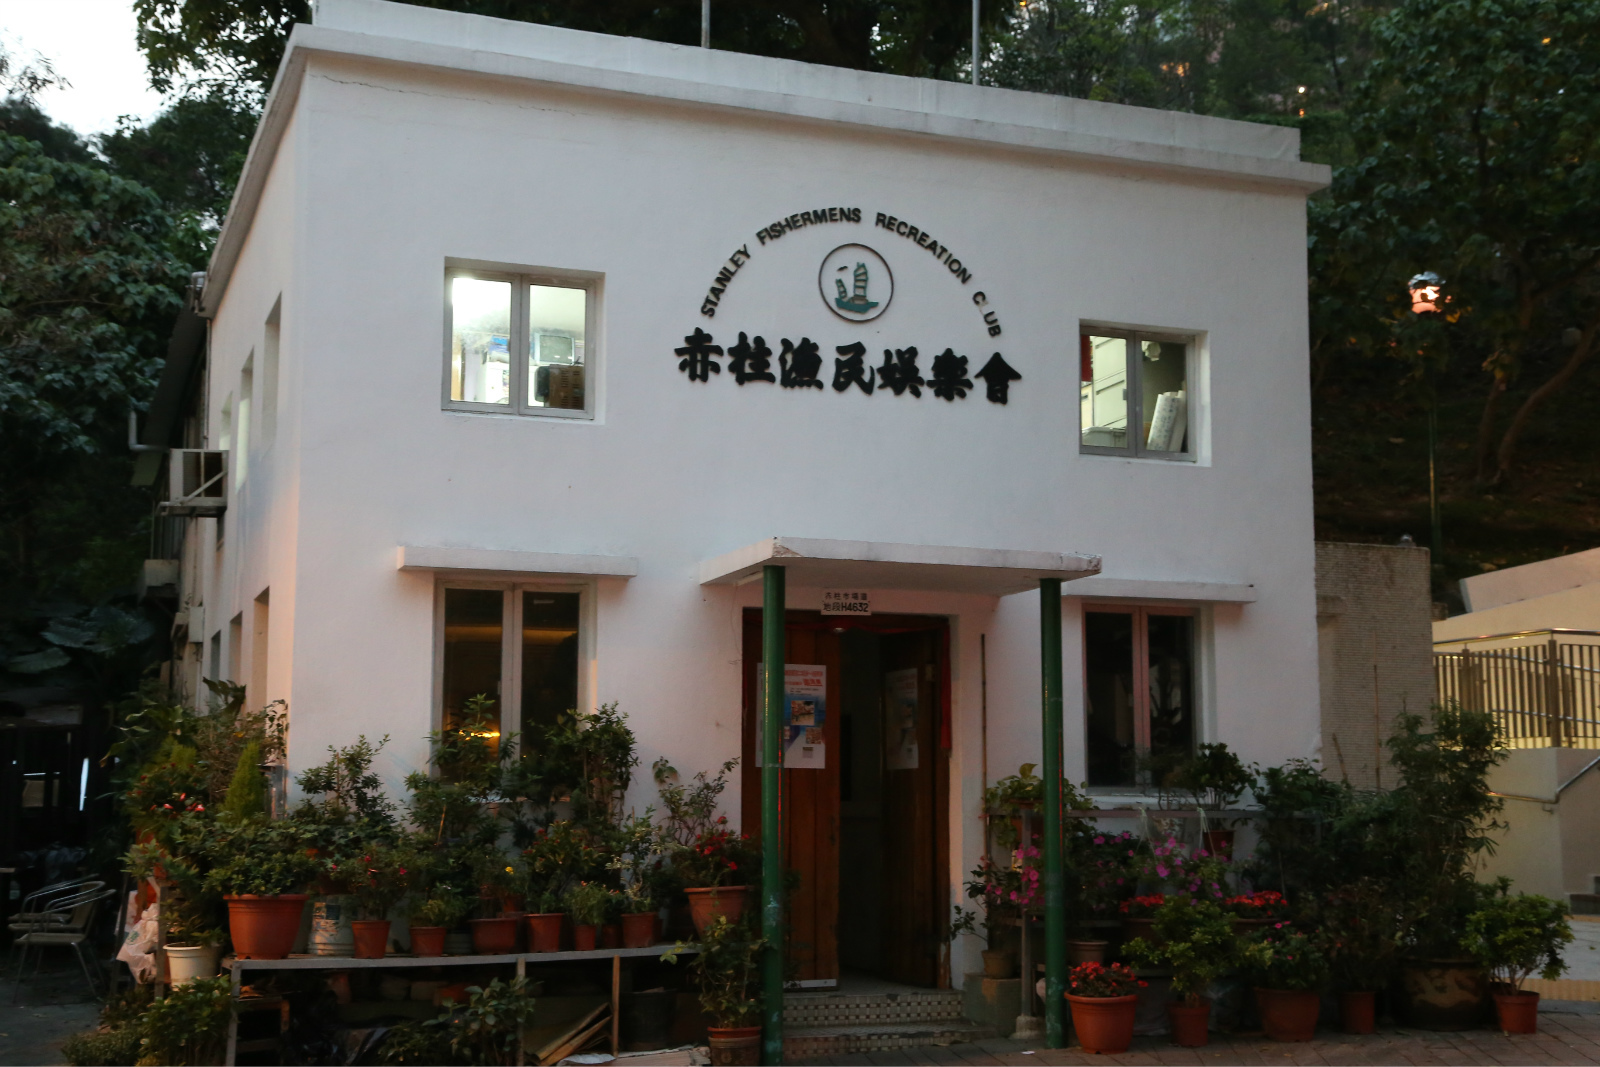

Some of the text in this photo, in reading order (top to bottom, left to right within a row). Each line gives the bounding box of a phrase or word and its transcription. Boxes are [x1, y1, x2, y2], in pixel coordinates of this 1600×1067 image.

[701, 207, 1002, 338] STANLEY FISHERMENS RECREATION CUB
